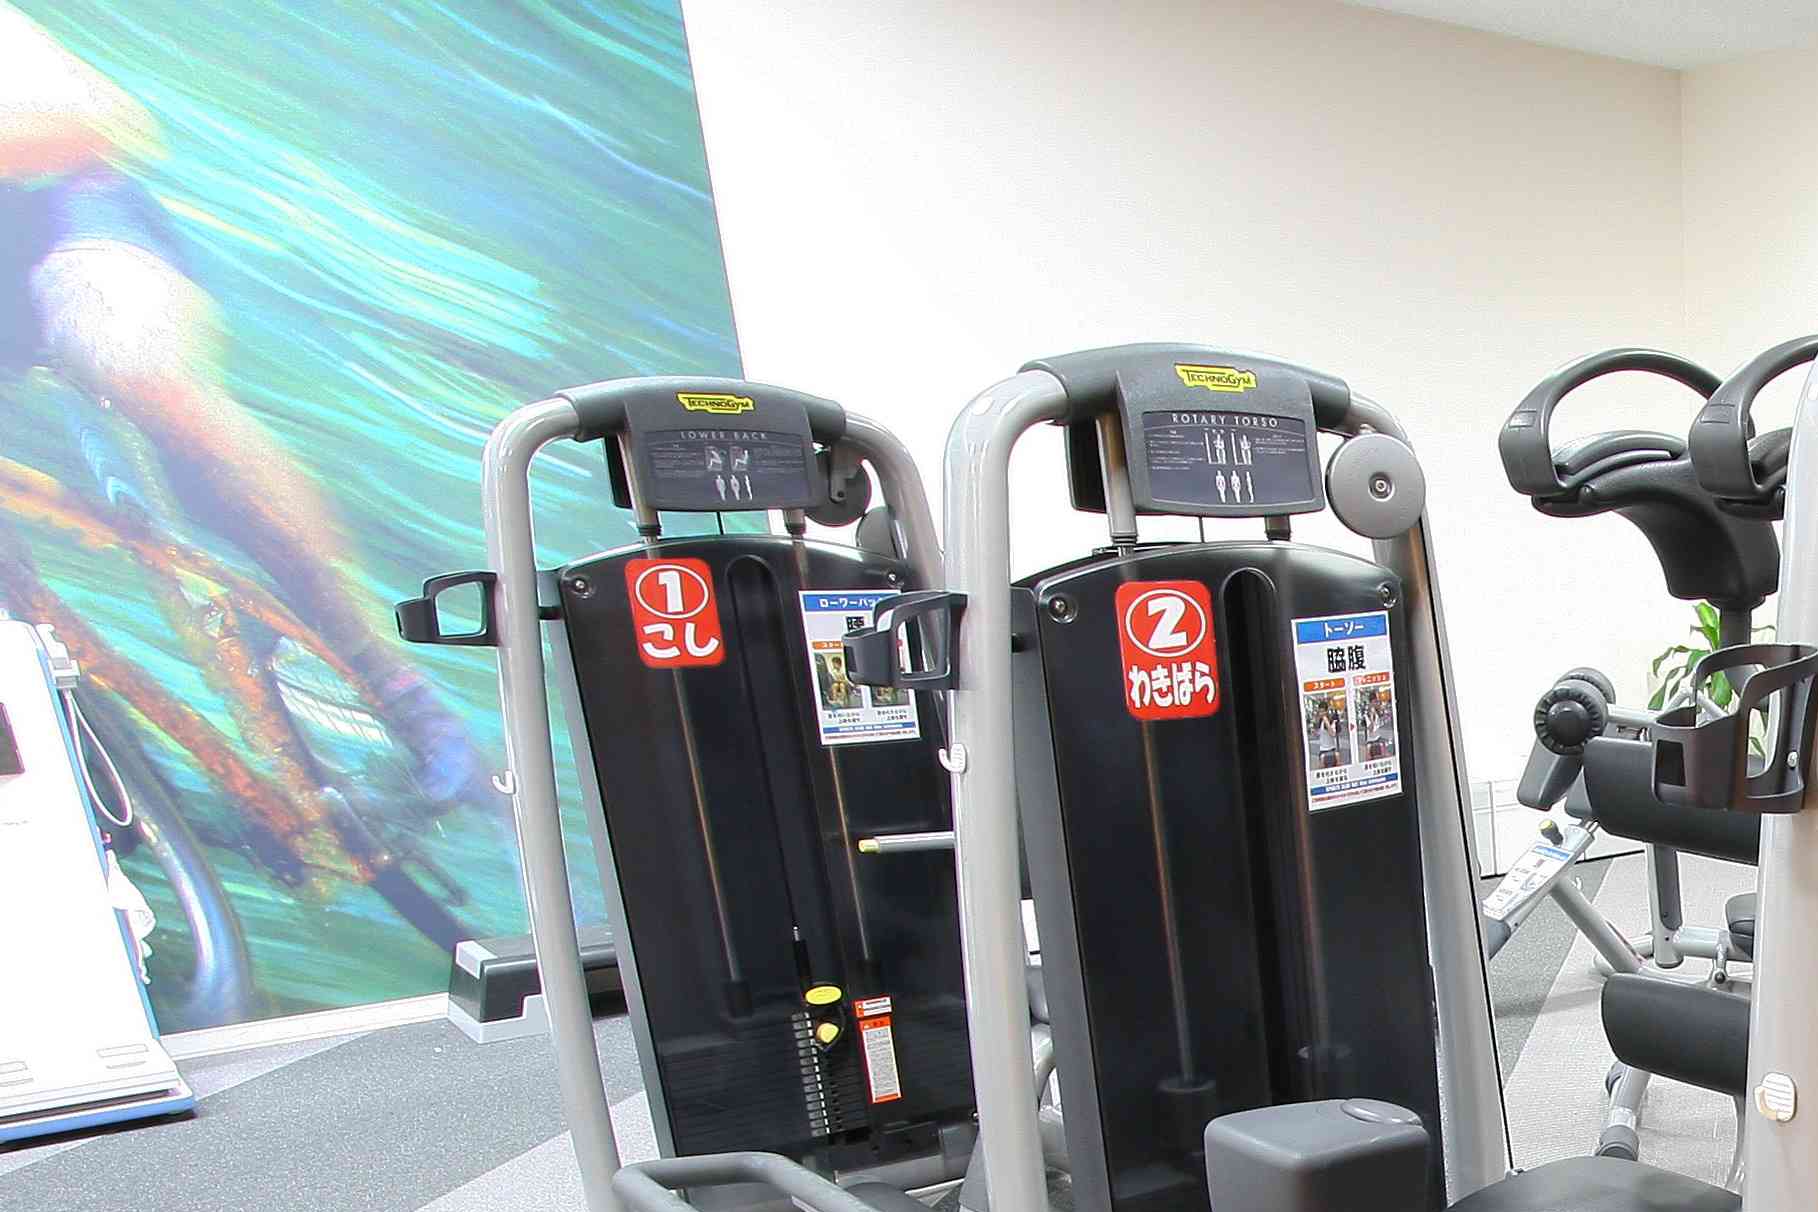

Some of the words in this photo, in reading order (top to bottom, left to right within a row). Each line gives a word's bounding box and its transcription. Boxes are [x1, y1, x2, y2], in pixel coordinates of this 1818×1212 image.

[1172, 412, 1227, 426] ROTARY
[1233, 415, 1280, 428] TORSO
[680, 431, 725, 440] LOWER
[733, 431, 768, 441] BACK
[642, 622, 720, 659] こし
[1324, 621, 1365, 638] トーソー
[1326, 645, 1366, 673] 脇腹
[1128, 661, 1216, 708] わきばら
